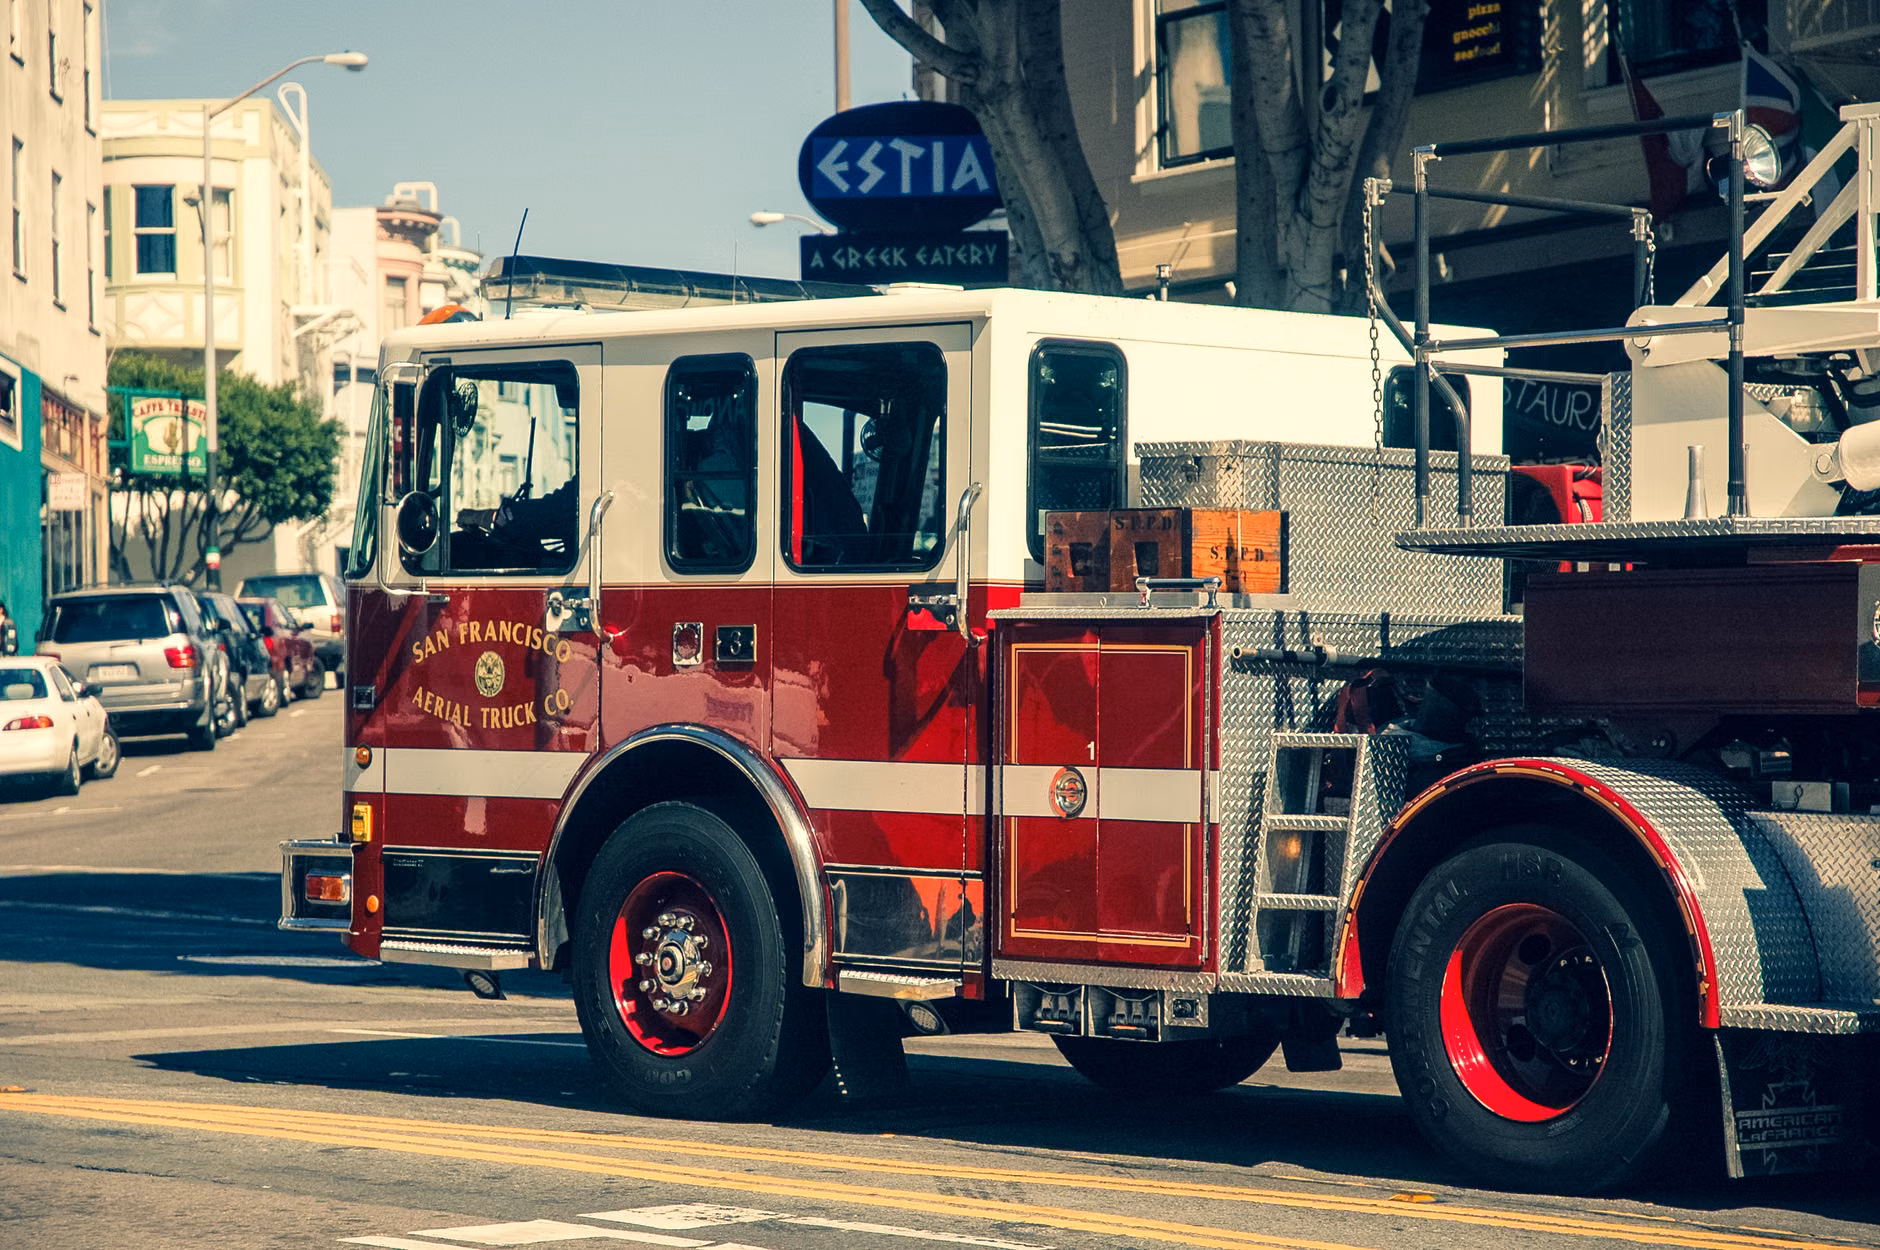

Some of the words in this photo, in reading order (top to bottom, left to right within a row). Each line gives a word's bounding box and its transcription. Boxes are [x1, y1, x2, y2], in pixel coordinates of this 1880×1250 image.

[1468, 3, 1500, 20] pizza
[1453, 22, 1500, 44] gnocchi
[1455, 42, 1500, 61] seafood
[817, 138, 989, 194] ESTIA
[810, 250, 824, 268] A
[832, 247, 908, 270] GREEK
[915, 243, 998, 267] EATERY
[412, 628, 450, 664] SAN
[458, 620, 571, 663] FRANCISCO
[412, 686, 472, 727] AERIAL
[481, 701, 537, 729] TRUCK
[544, 689, 574, 716] CO.
[1086, 741, 1095, 760] 1
[1738, 1113, 1842, 1130] AMERICAN
